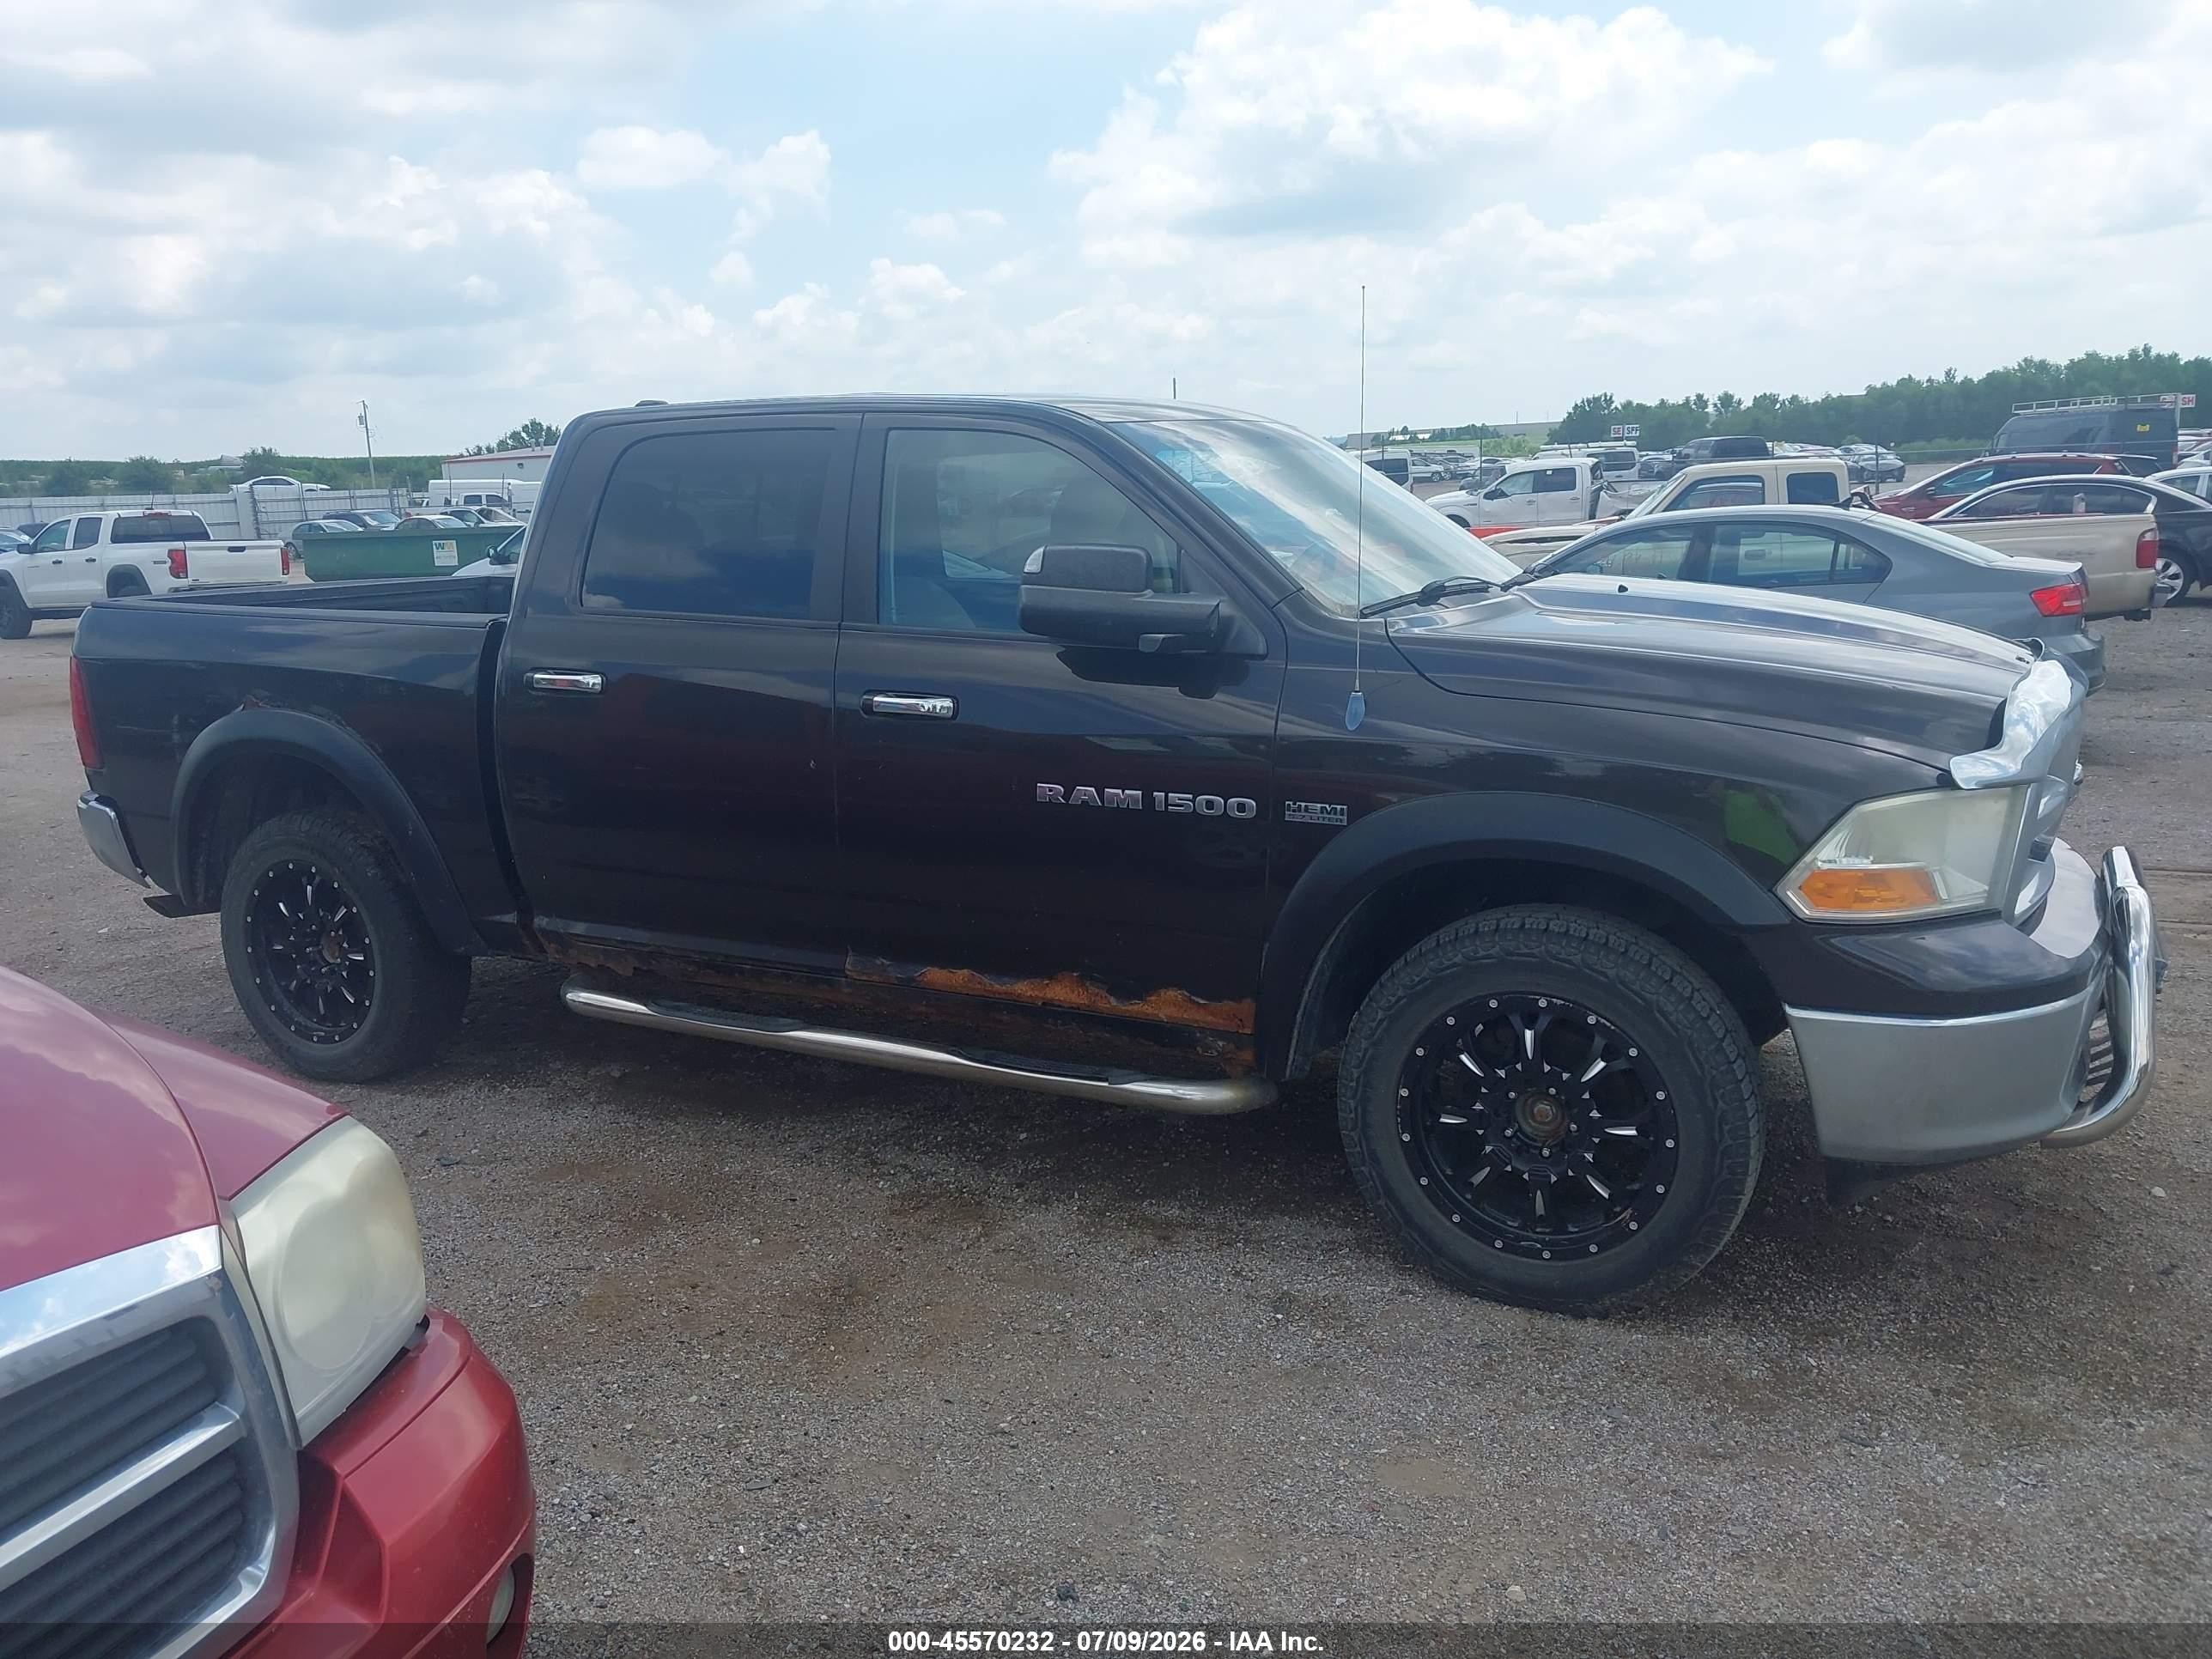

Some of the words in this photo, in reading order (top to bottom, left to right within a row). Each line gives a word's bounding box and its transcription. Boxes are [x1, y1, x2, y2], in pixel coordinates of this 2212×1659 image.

[1036, 783, 1142, 810] RAM
[1153, 792, 1256, 818] 1500
[1285, 801, 1347, 817] HEMI
